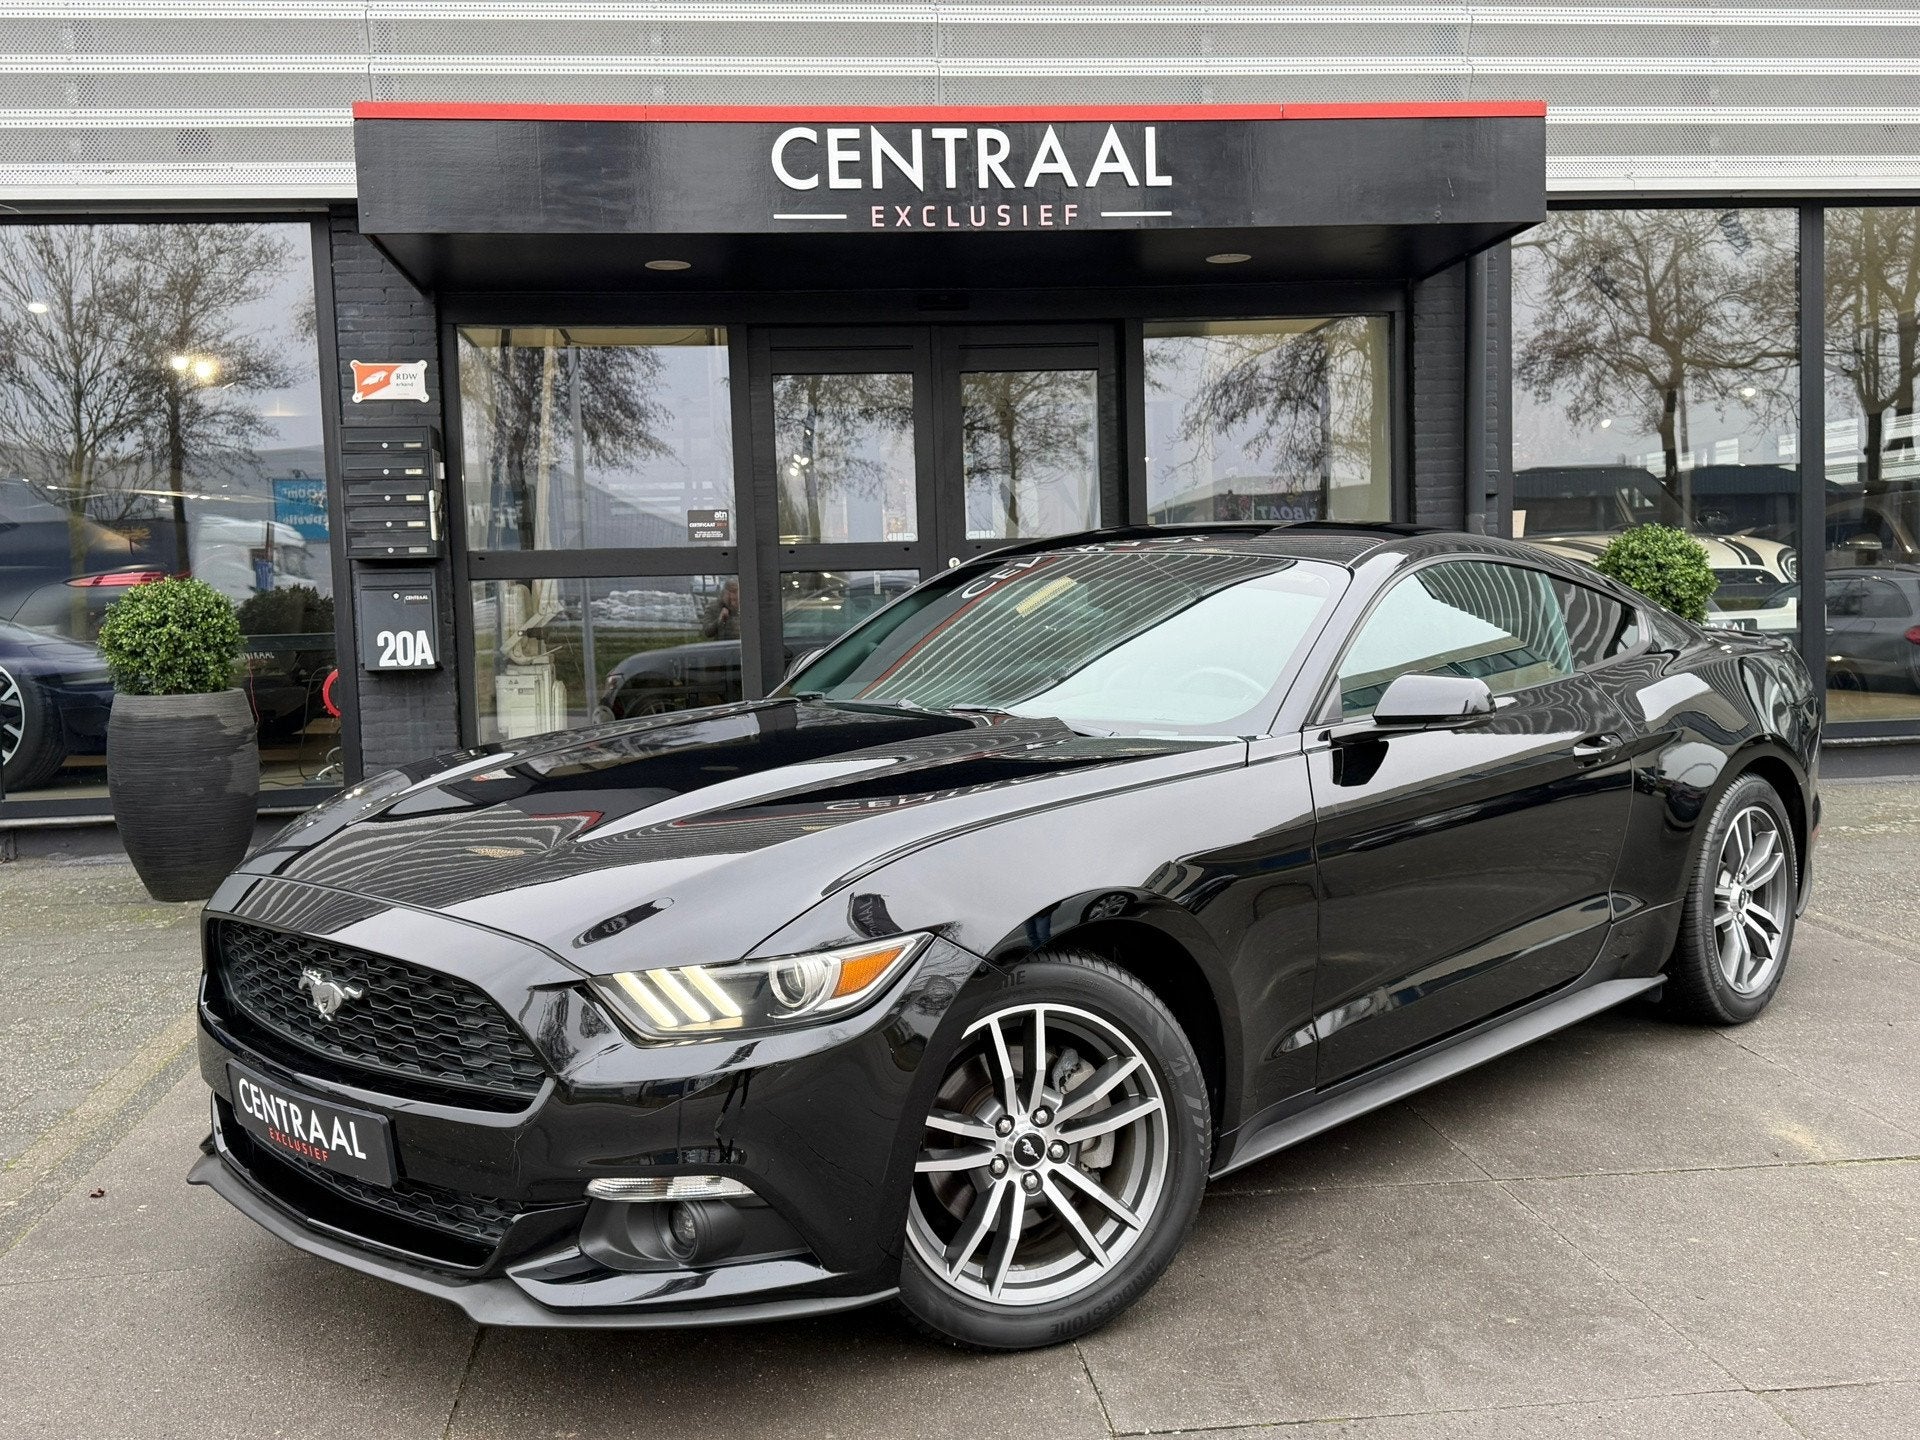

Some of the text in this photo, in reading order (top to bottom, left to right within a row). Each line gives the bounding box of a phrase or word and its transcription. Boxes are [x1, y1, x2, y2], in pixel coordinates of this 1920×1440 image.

[771, 123, 1173, 192] CENTRAAL
[871, 204, 1079, 228] EXCLUSIEF
[376, 629, 435, 667] 20A
[238, 1077, 367, 1160] CENTRAAL
[269, 1127, 329, 1162] EXCLUSIEF
